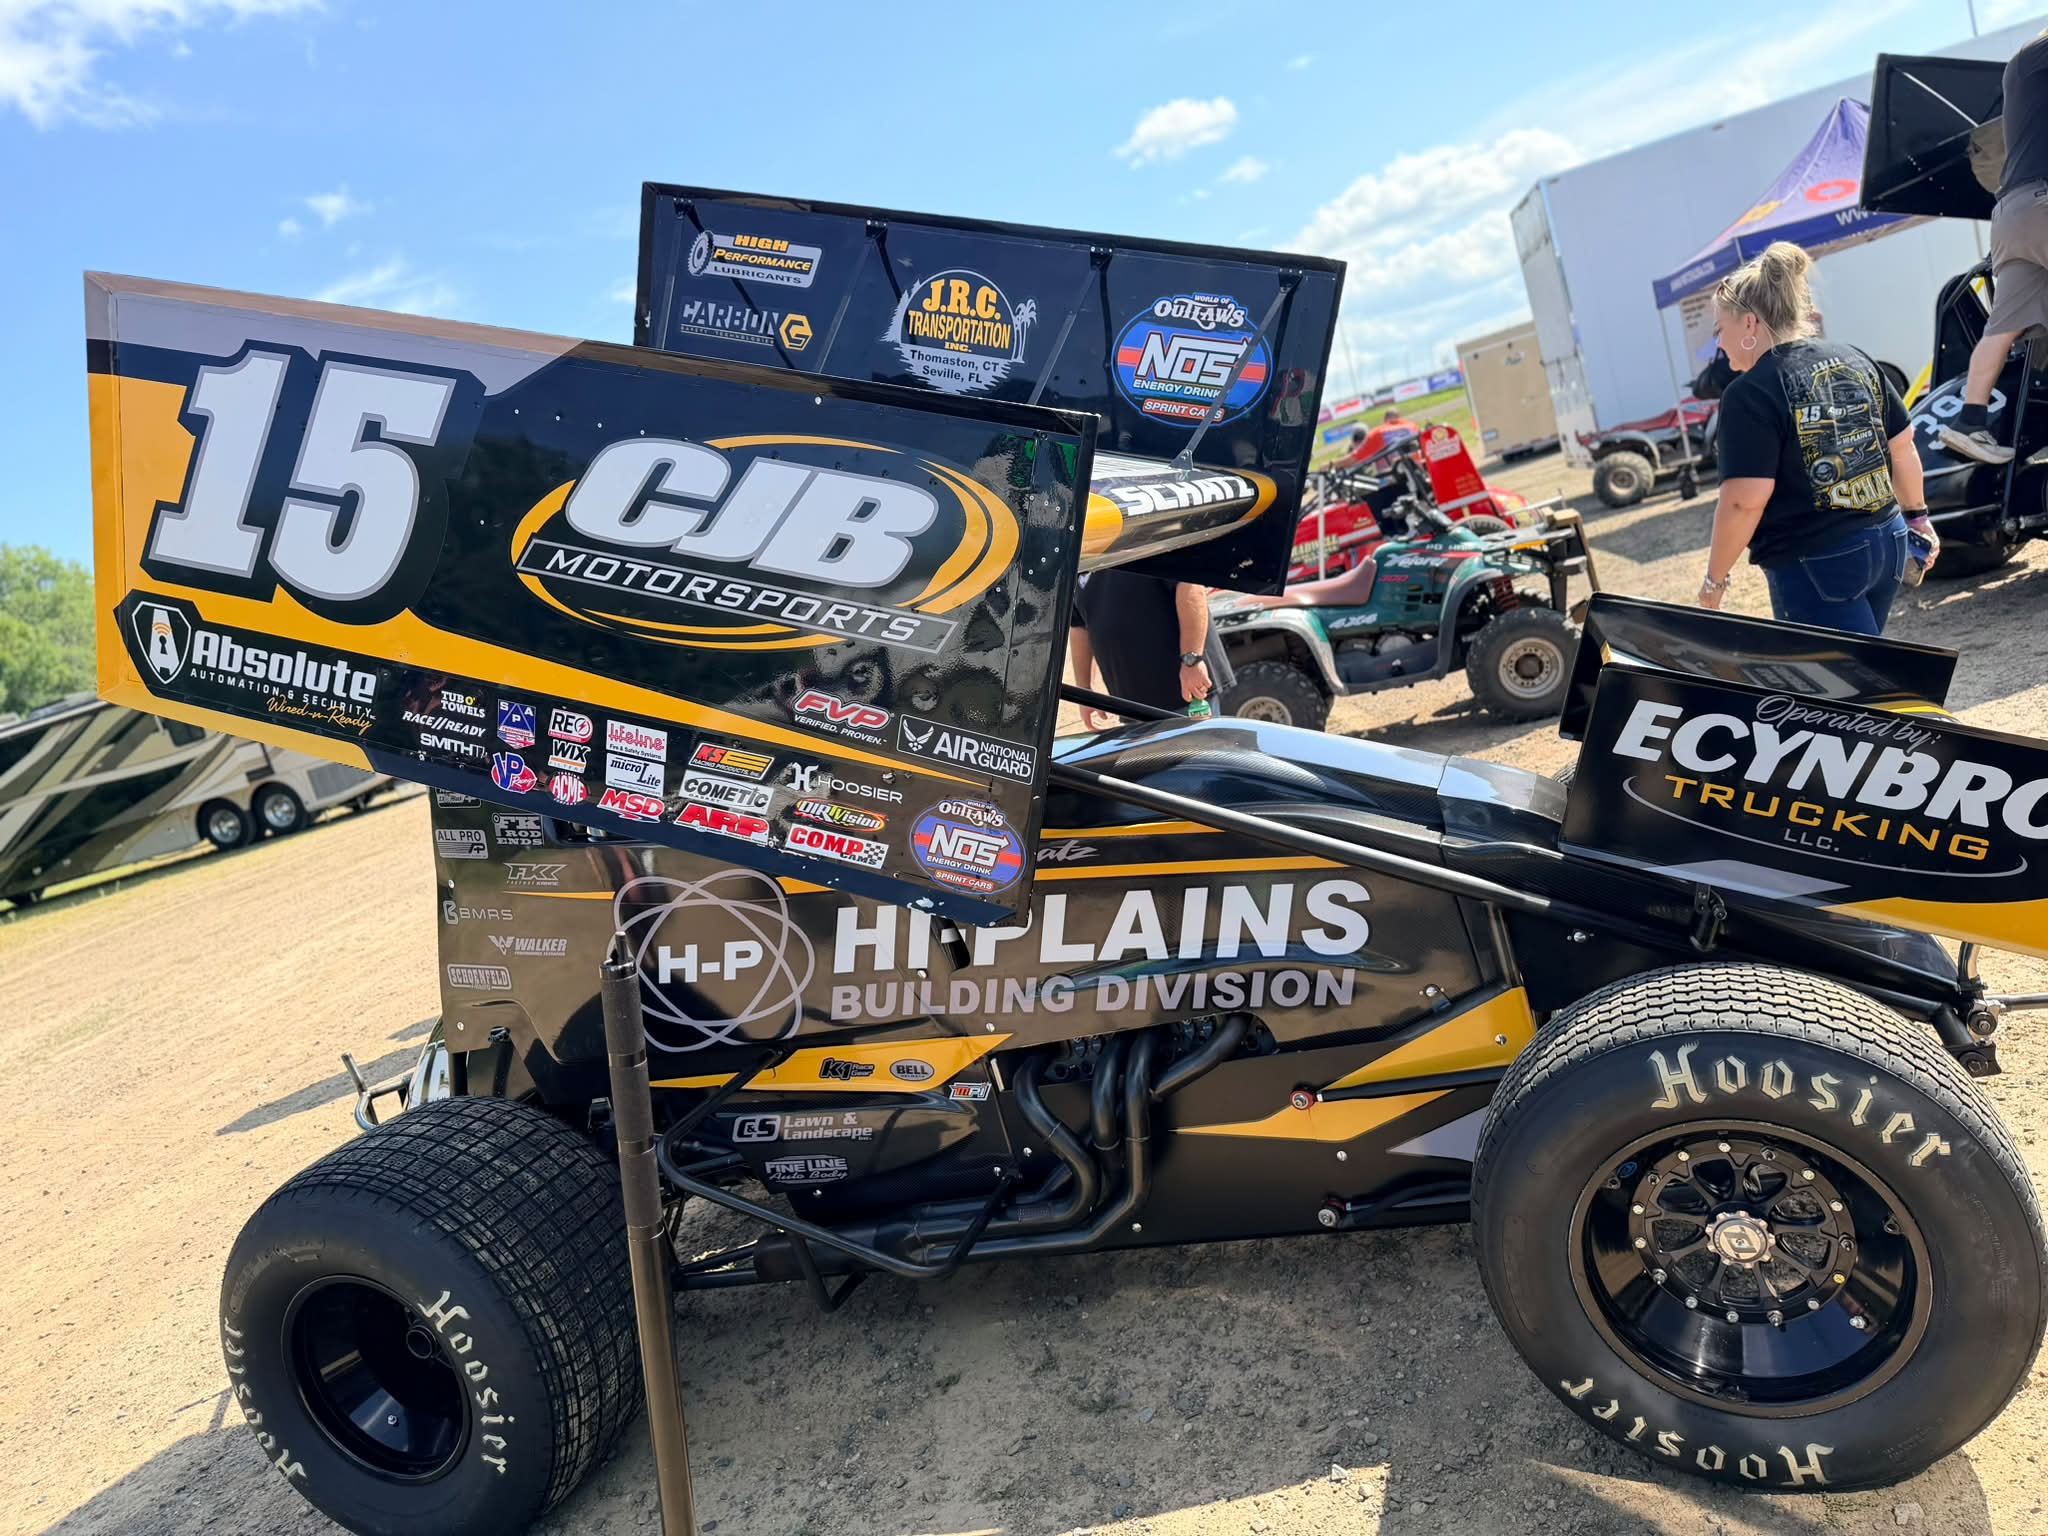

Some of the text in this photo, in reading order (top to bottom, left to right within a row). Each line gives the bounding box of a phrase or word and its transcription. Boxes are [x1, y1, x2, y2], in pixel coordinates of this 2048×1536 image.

[734, 235, 789, 252] HIGH
[713, 248, 813, 271] PERFORMANCE
[714, 265, 802, 284] LUBRICANTS
[922, 278, 1002, 320] J.R.C.
[1194, 295, 1219, 303] WORLD
[682, 300, 780, 336] CARBON
[908, 310, 1012, 349] TRANSPORTATION
[944, 341, 973, 353] INC.
[910, 349, 1000, 373] Thomaston, CT
[1136, 333, 1247, 387] NOS
[922, 365, 983, 384] Seville, FL
[1133, 380, 1222, 399] ENERGY DRINK
[1144, 401, 1224, 419] SPRINT CAS
[1800, 405, 1821, 424] 15
[149, 349, 457, 601] 15
[1110, 475, 1256, 517] SCHATZ
[565, 437, 939, 588] CJB
[545, 549, 922, 642] MOTORSPORTS
[192, 630, 377, 703] Absolute
[190, 668, 373, 717] AUTOMATION & SECURITY
[441, 690, 464, 704] TUB
[441, 700, 486, 718] TOWELS
[795, 689, 889, 729] FVP
[794, 714, 883, 745] VERIFIED. PROVEN.
[1756, 694, 1942, 752] Operated by:
[553, 739, 590, 763] WIX
[933, 731, 980, 765] AIR
[980, 741, 1033, 764] NATIONAL
[493, 751, 525, 790] VP
[692, 759, 716, 768] RACING
[978, 753, 1032, 778] GUARD
[552, 775, 585, 803] ACME
[684, 779, 769, 808] COMETIC
[817, 775, 904, 805] HOOSIER
[600, 788, 665, 817] MSD
[499, 816, 541, 829] FK
[678, 804, 769, 837] ARP
[1665, 774, 1990, 862] TRUCKING
[438, 830, 482, 842] ALL PRO
[496, 838, 543, 846] ENDS
[790, 827, 865, 855] COMP
[928, 824, 1003, 867] NOS
[1783, 829, 1841, 853] LLC.
[840, 851, 877, 866] CAMS
[1036, 839, 1100, 862] atz
[926, 855, 992, 876] ENERGY DRINK
[935, 871, 994, 890] SPRINT CARS
[459, 907, 514, 921] BMRS
[515, 937, 568, 952] WALKER
[658, 939, 764, 985] H-P
[450, 967, 508, 986] SCHOENFELD
[831, 968, 1356, 1020] BUILDING DIVISION
[896, 1064, 929, 1075] BELL
[1648, 1041, 1953, 1168] Hoosier
[784, 1112, 858, 1128] Lawn &
[783, 1127, 873, 1140] Landscape
[765, 1158, 848, 1174] FINE LINE
[417, 1290, 516, 1475] Hoosier
[1561, 1375, 1835, 1487] Hoosier
